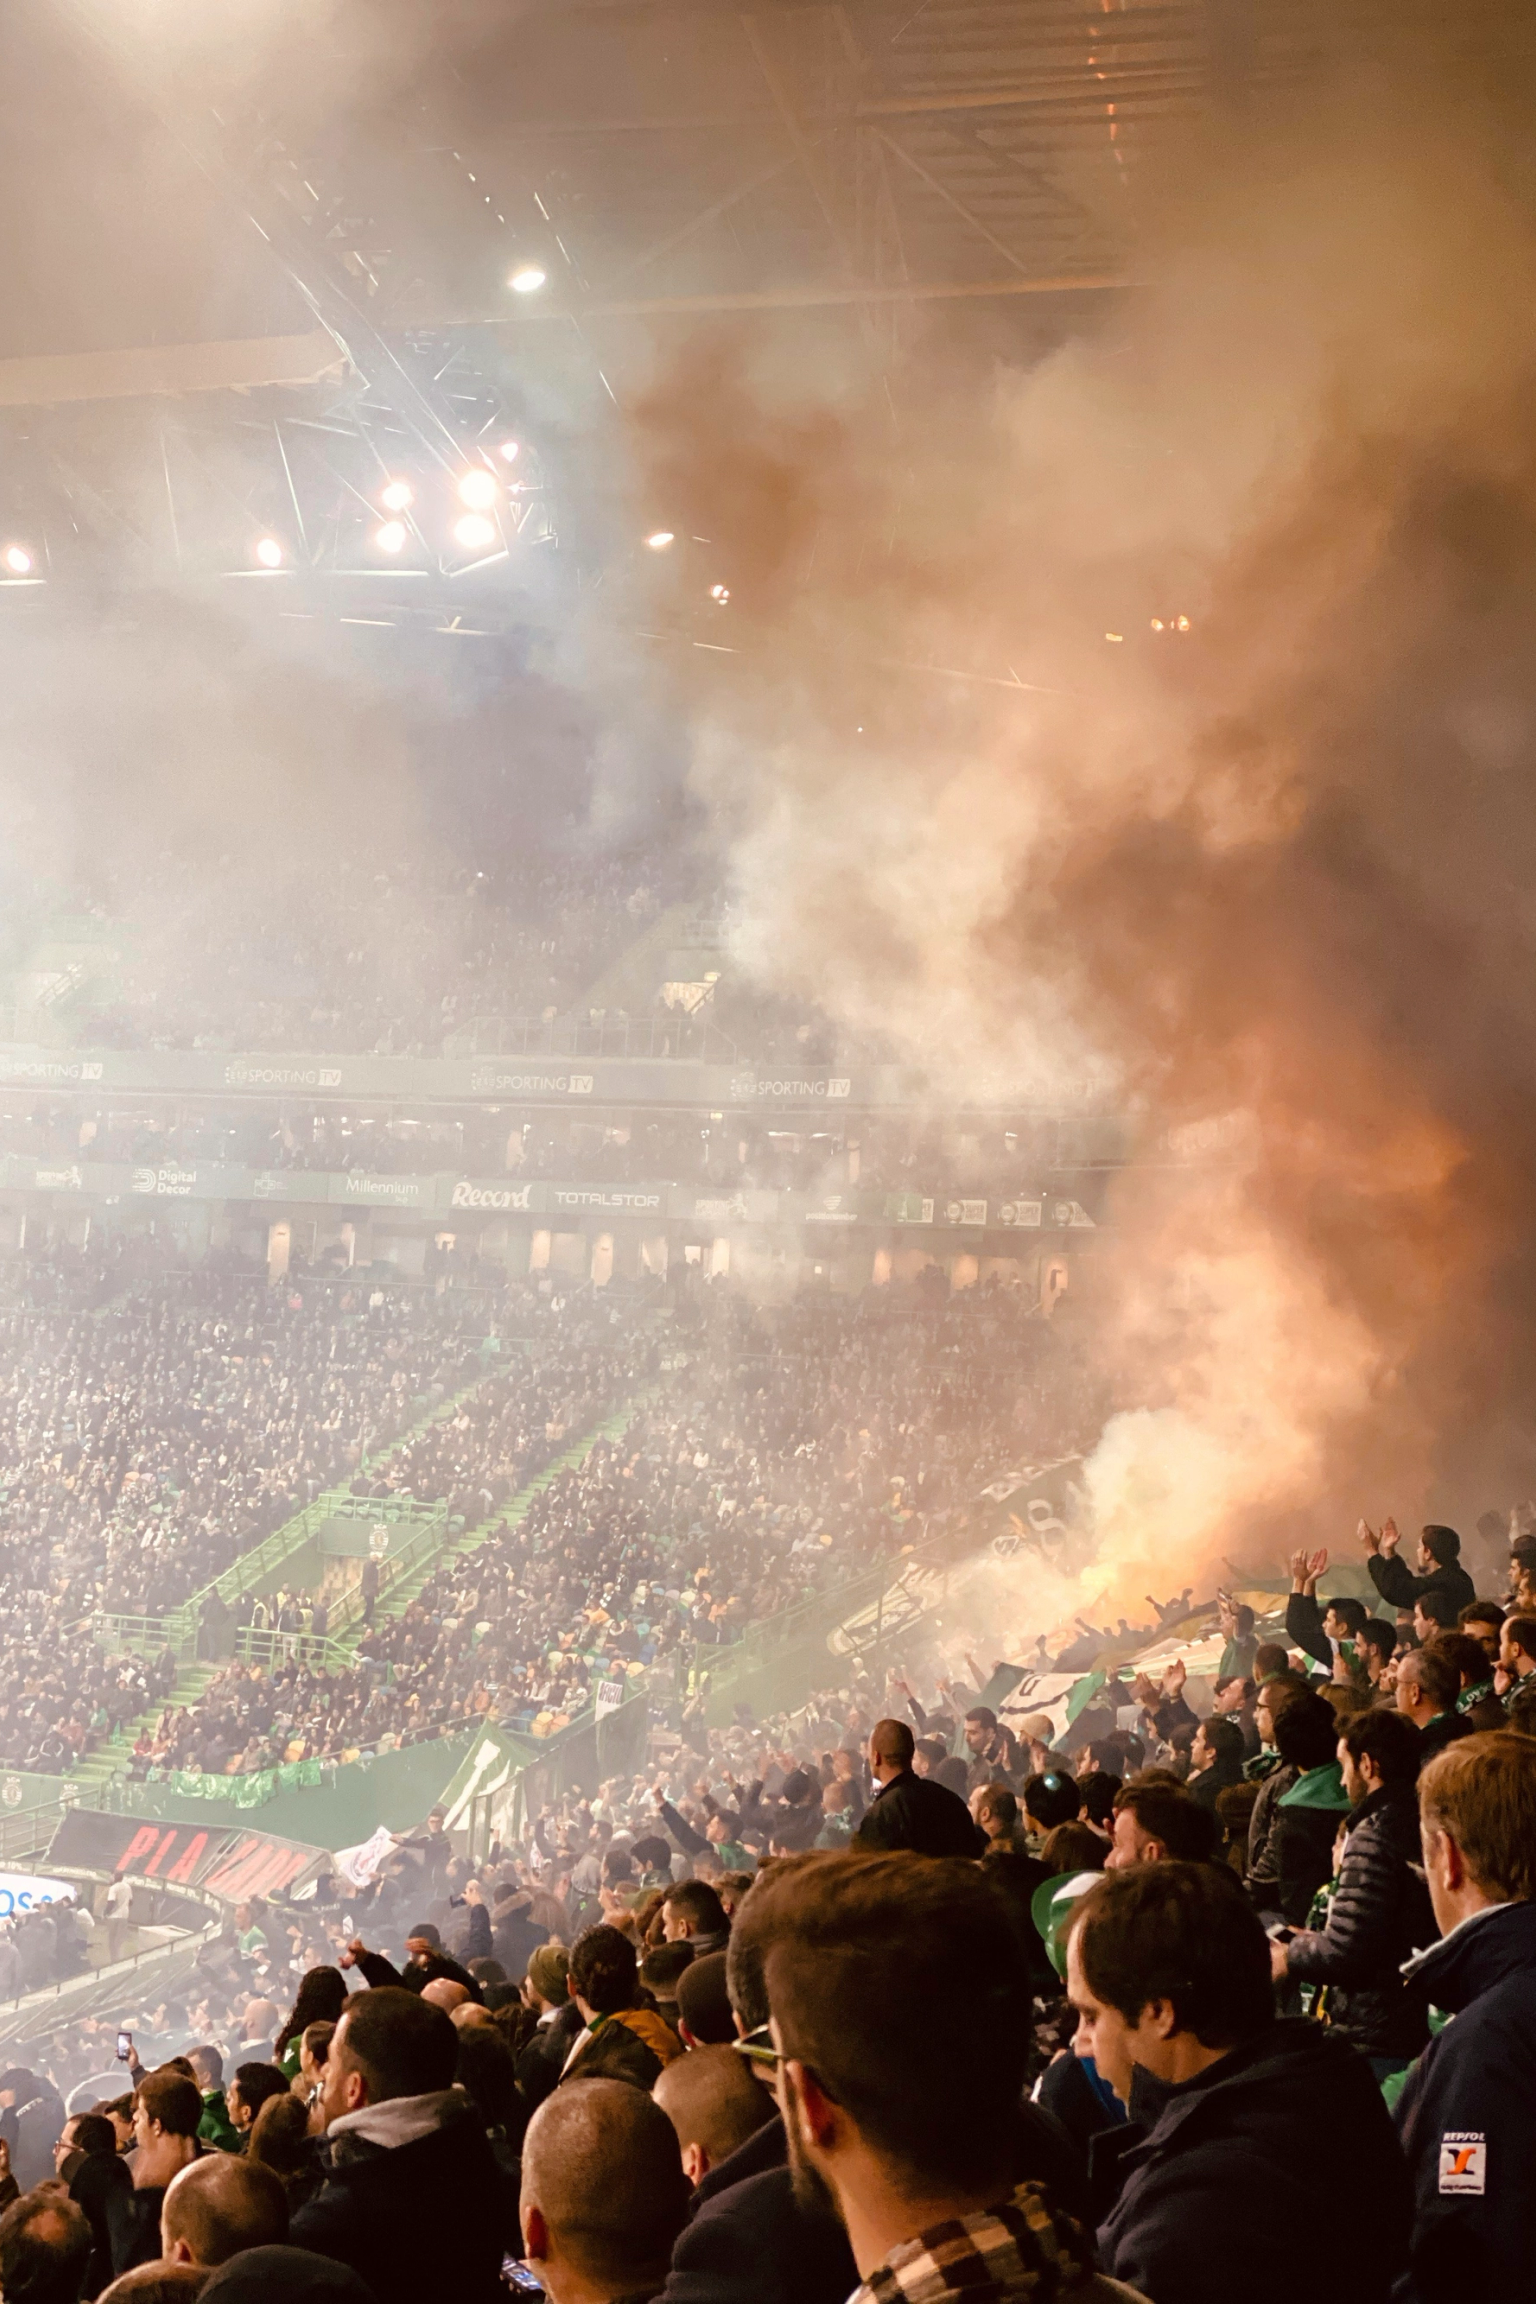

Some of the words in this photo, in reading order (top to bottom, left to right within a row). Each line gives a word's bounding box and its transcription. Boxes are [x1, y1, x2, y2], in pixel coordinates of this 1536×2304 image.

[11, 1062, 79, 1079] SPORTING
[248, 1068, 317, 1085] SPORTING
[320, 1069, 341, 1086] TV
[496, 1075, 567, 1092] SPORTING
[570, 1075, 593, 1093] TV
[758, 1080, 826, 1096] SPORTING
[828, 1079, 850, 1097] TV
[158, 1170, 197, 1184] Digital
[345, 1176, 419, 1195] Millennium
[157, 1182, 192, 1195] Decor
[451, 1181, 534, 1209] Record
[555, 1191, 660, 1208] TOTALSTOR
[1442, 2132, 1486, 2142] REPSOL
